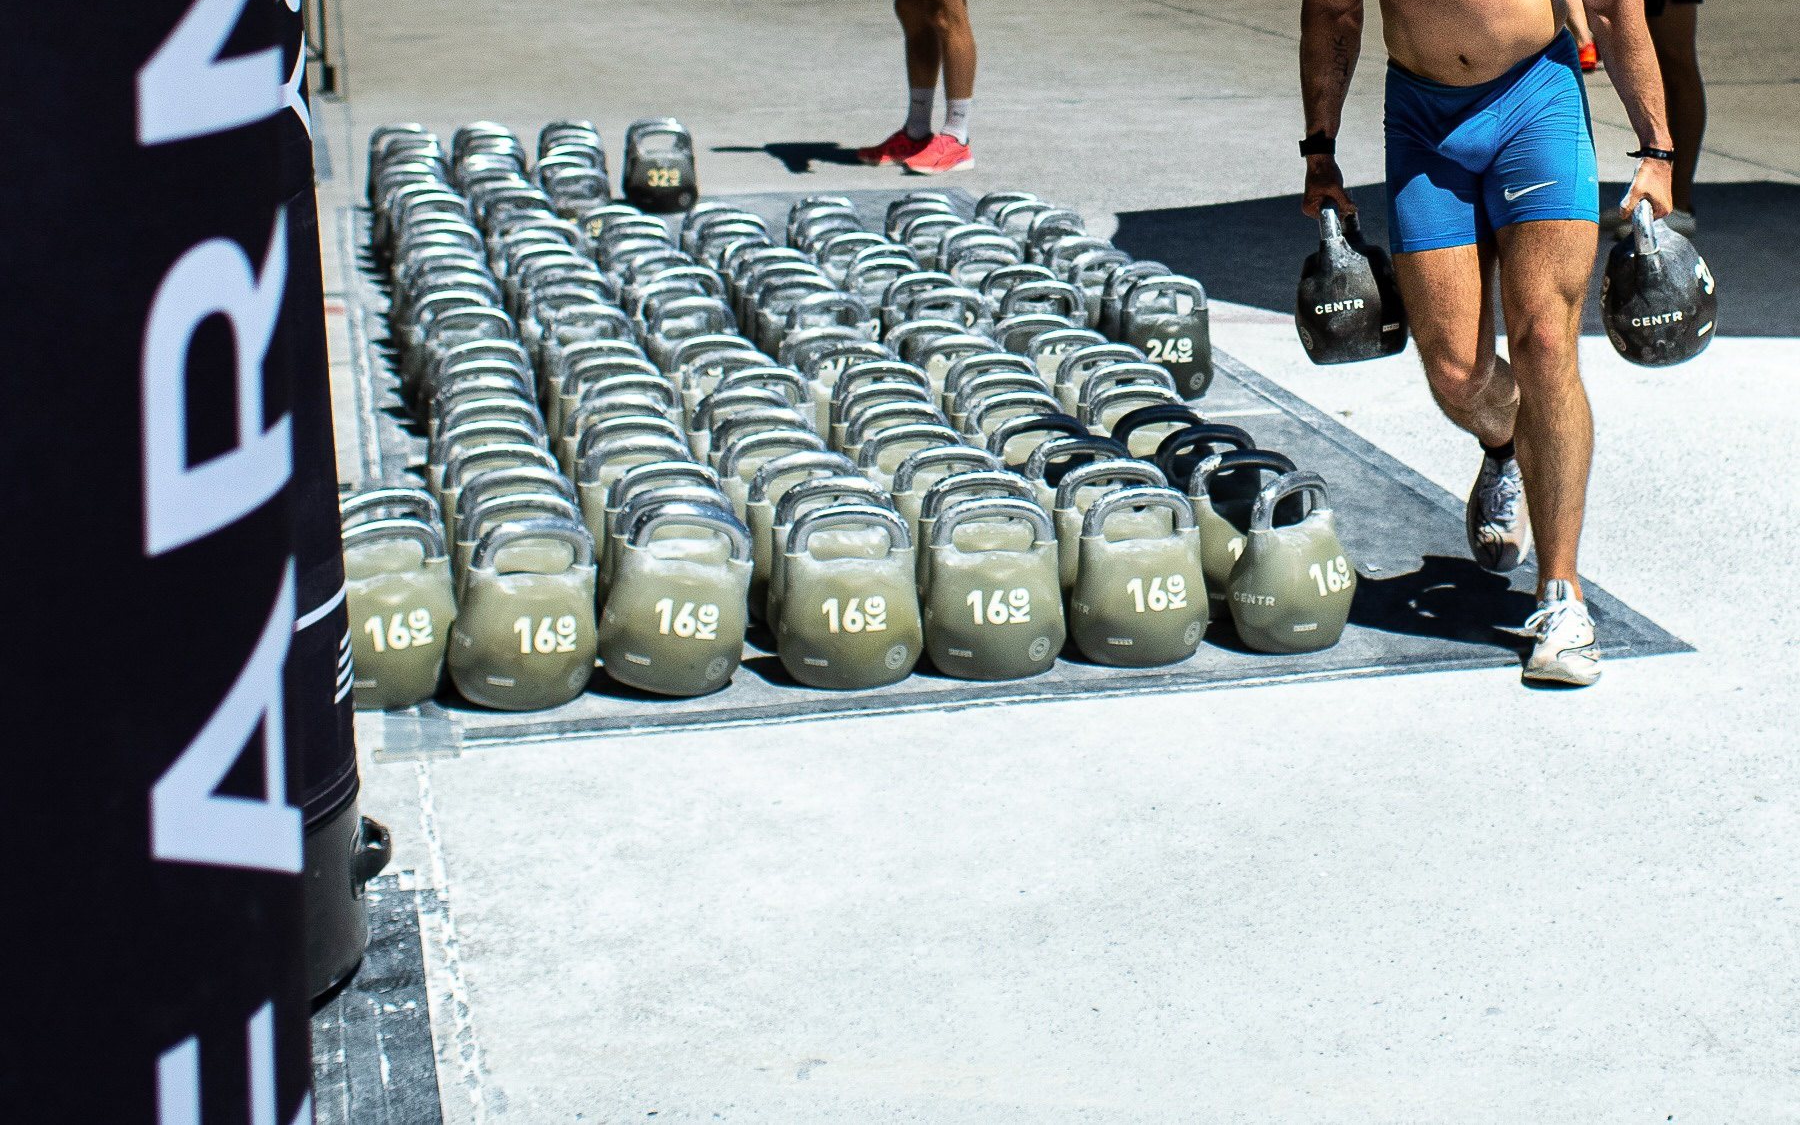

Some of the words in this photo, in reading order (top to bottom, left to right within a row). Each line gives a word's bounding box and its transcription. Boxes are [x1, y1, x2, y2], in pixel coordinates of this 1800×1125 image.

[1315, 298, 1364, 315] CENTR
[1631, 310, 1683, 327] CENTR
[1234, 591, 1276, 607] CENTR
